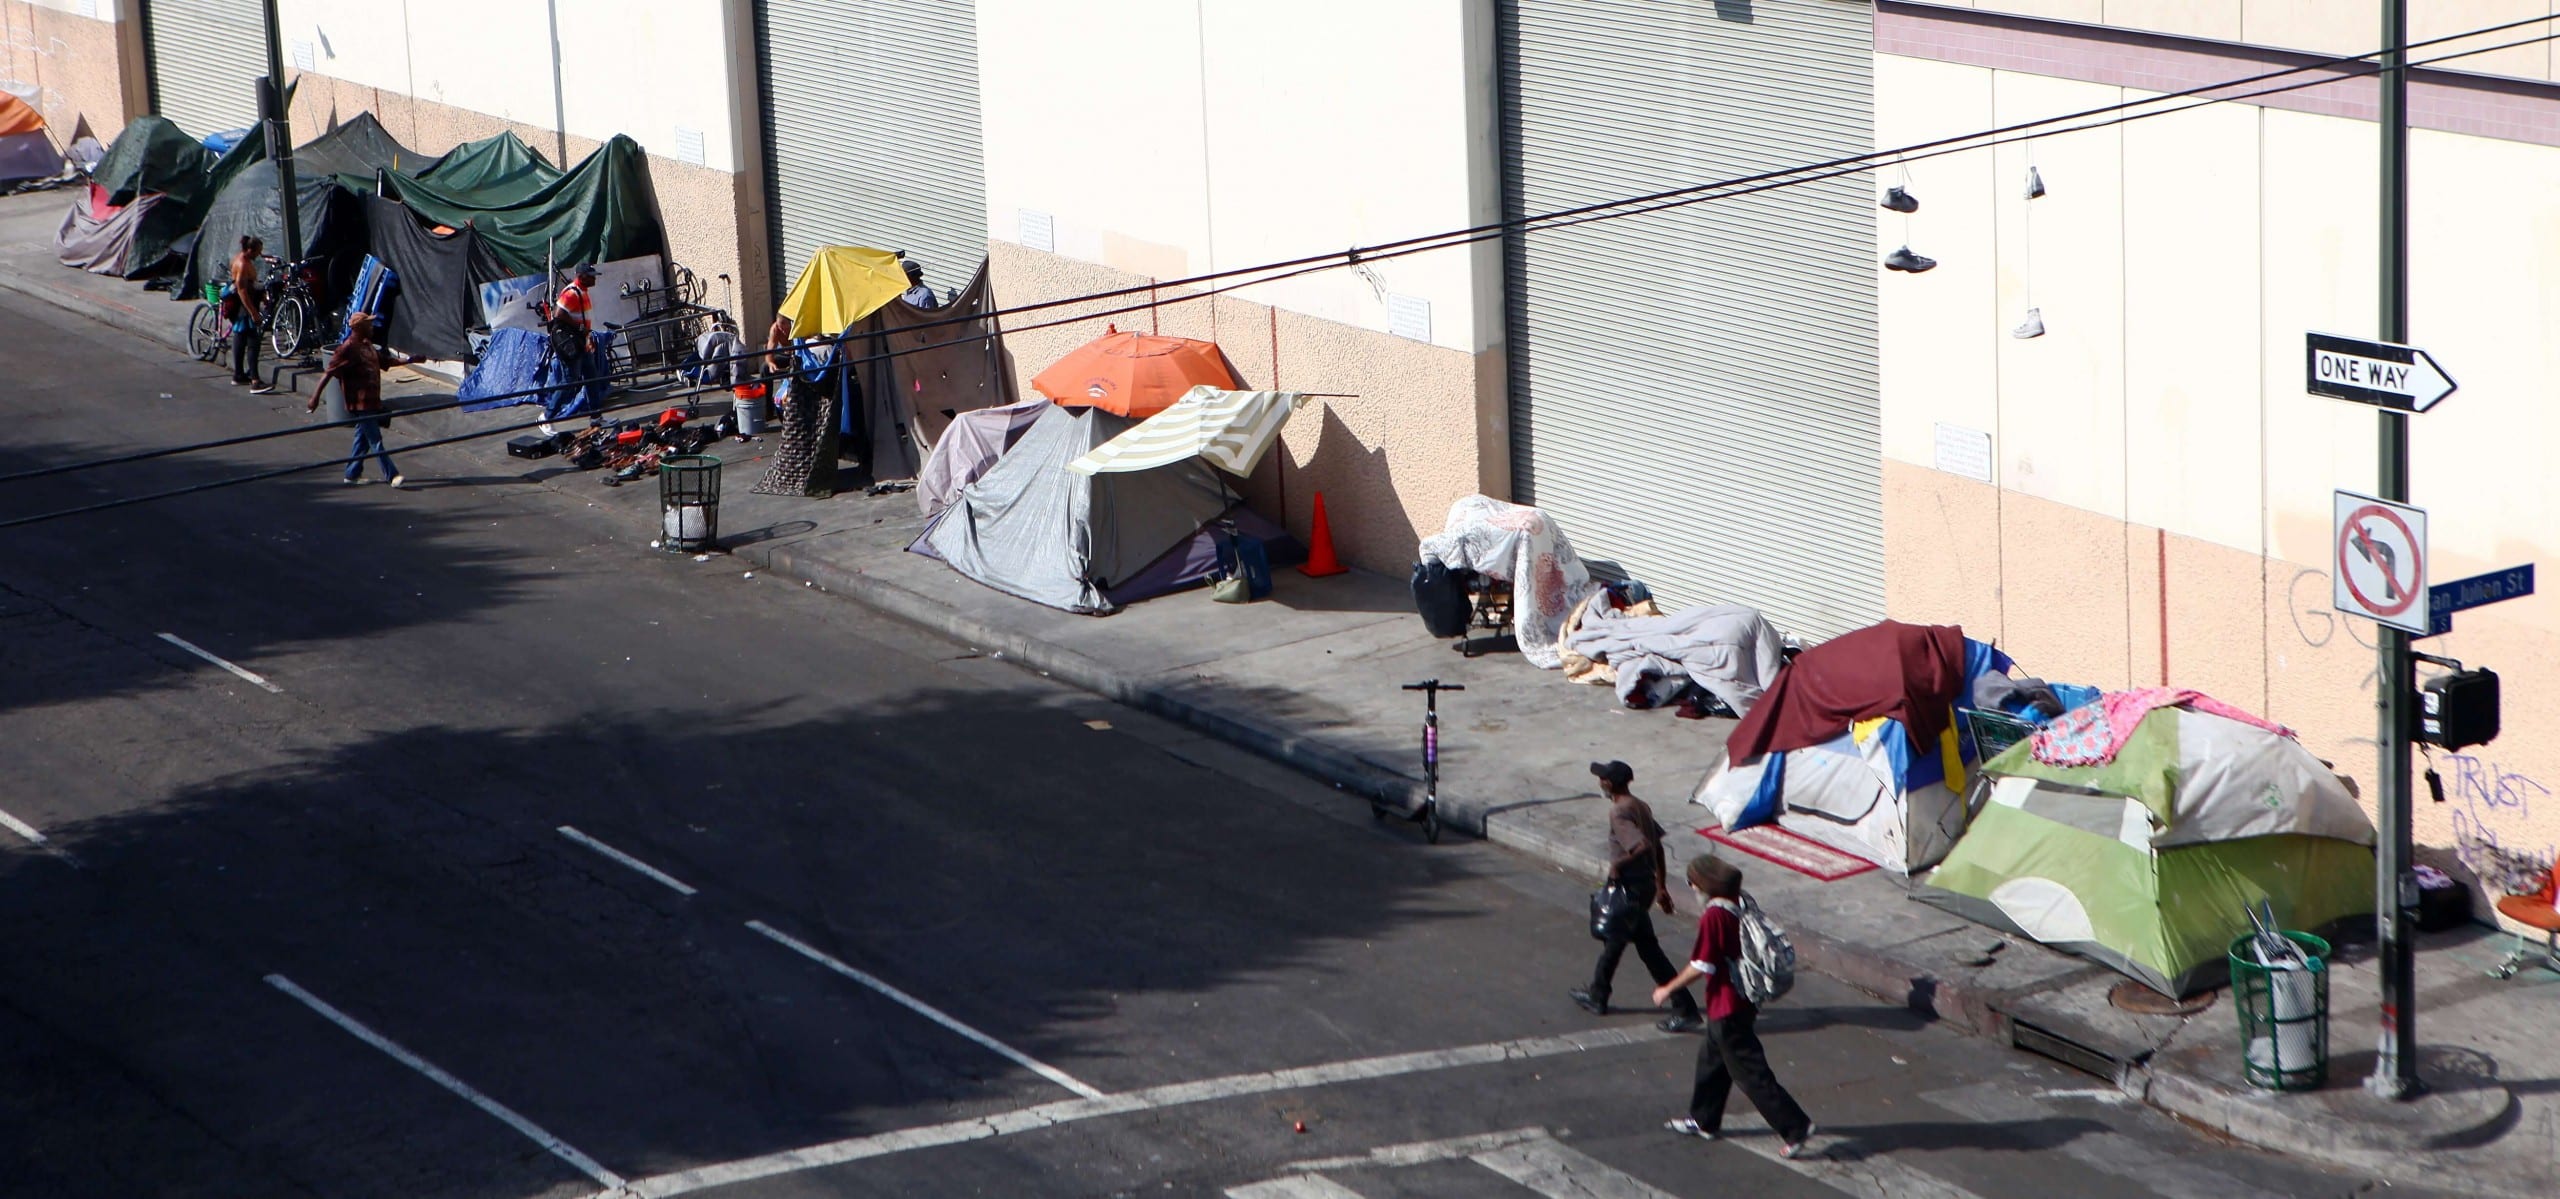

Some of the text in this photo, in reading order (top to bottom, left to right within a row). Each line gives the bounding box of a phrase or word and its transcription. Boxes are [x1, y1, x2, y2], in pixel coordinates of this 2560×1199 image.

[2321, 355, 2409, 390] ONE WAY
[2429, 571, 2525, 611] an Julian St
[2442, 754, 2552, 818] TRUST
